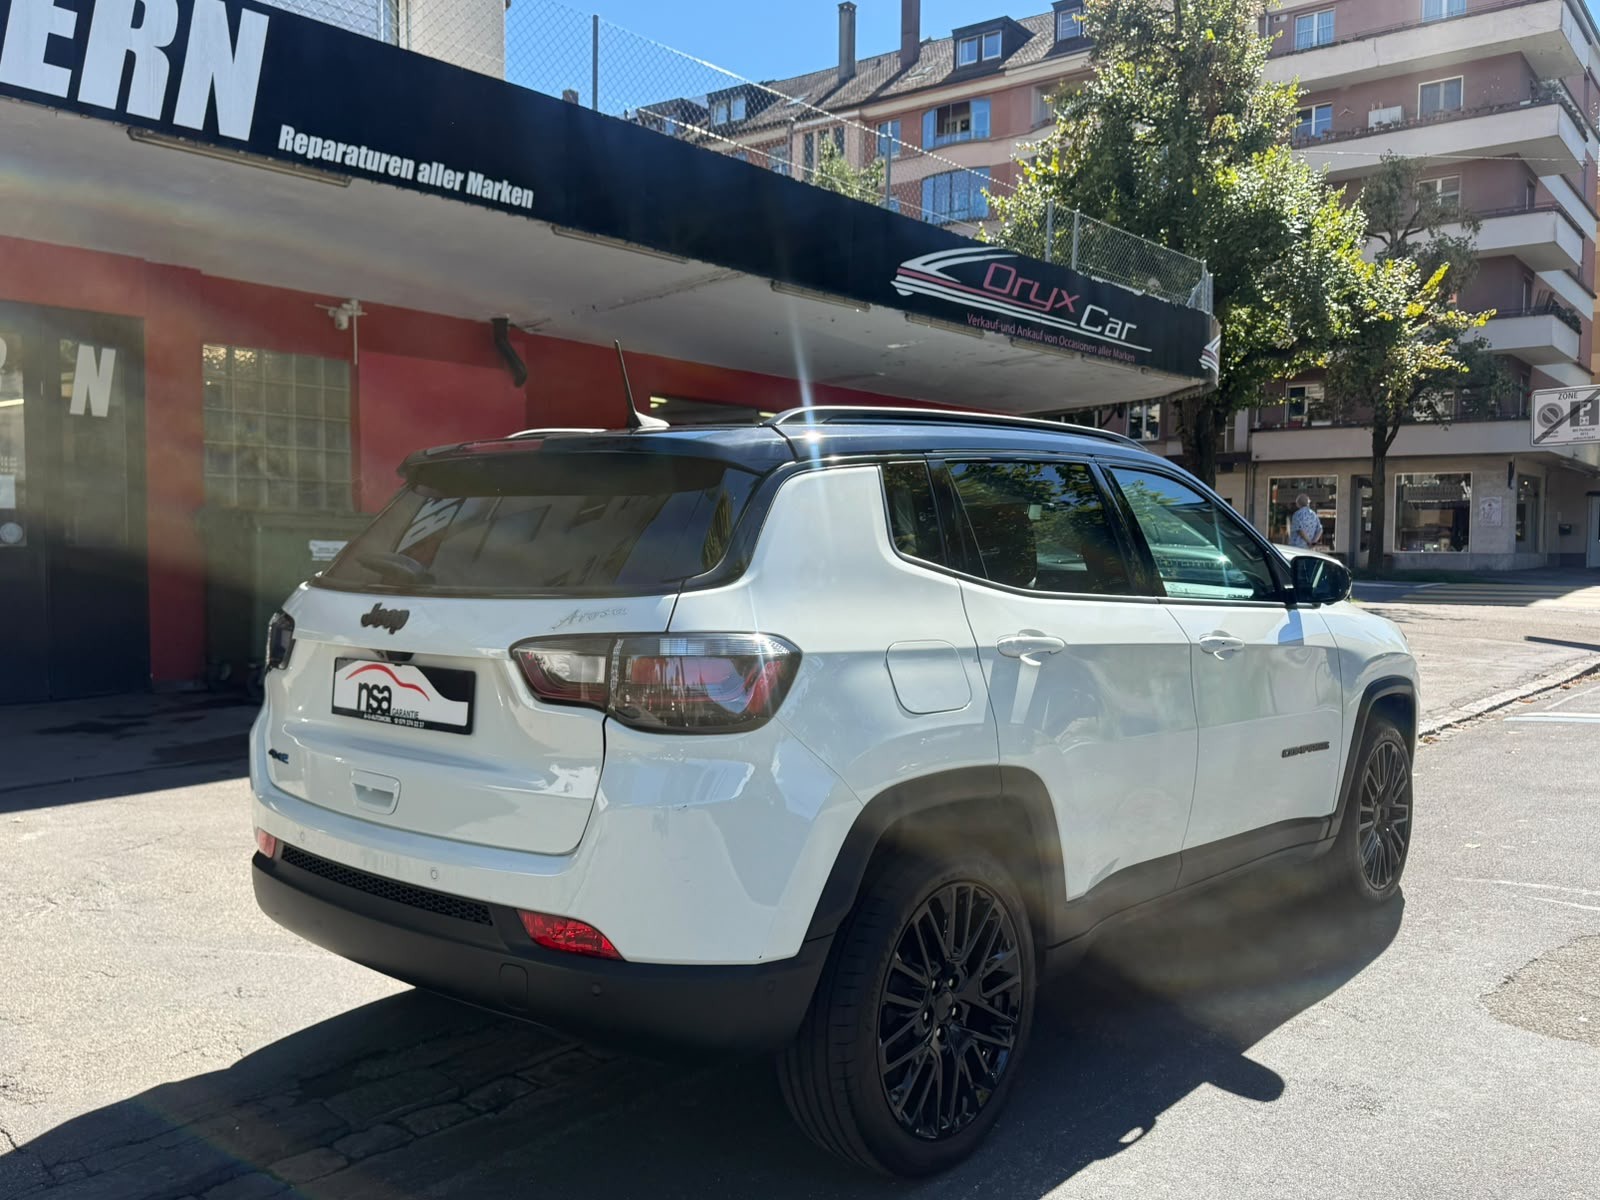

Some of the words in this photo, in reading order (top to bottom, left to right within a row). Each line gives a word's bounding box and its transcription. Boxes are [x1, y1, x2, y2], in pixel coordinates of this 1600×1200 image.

[0, 0, 269, 141] ERN
[278, 124, 415, 181] Reparaturen
[417, 161, 465, 191] aller
[466, 171, 534, 209] Marken
[983, 262, 1080, 312] Oryx
[1080, 304, 1137, 340] Car
[1017, 325, 1044, 341] Ankauf
[1044, 334, 1058, 345] von
[1059, 335, 1097, 353] Occasionen
[1098, 344, 1112, 357] aller
[1113, 349, 1136, 362] Marken
[1558, 392, 1577, 400] ZONE
[357, 682, 392, 716] nsa
[392, 707, 419, 720] GARANTIE
